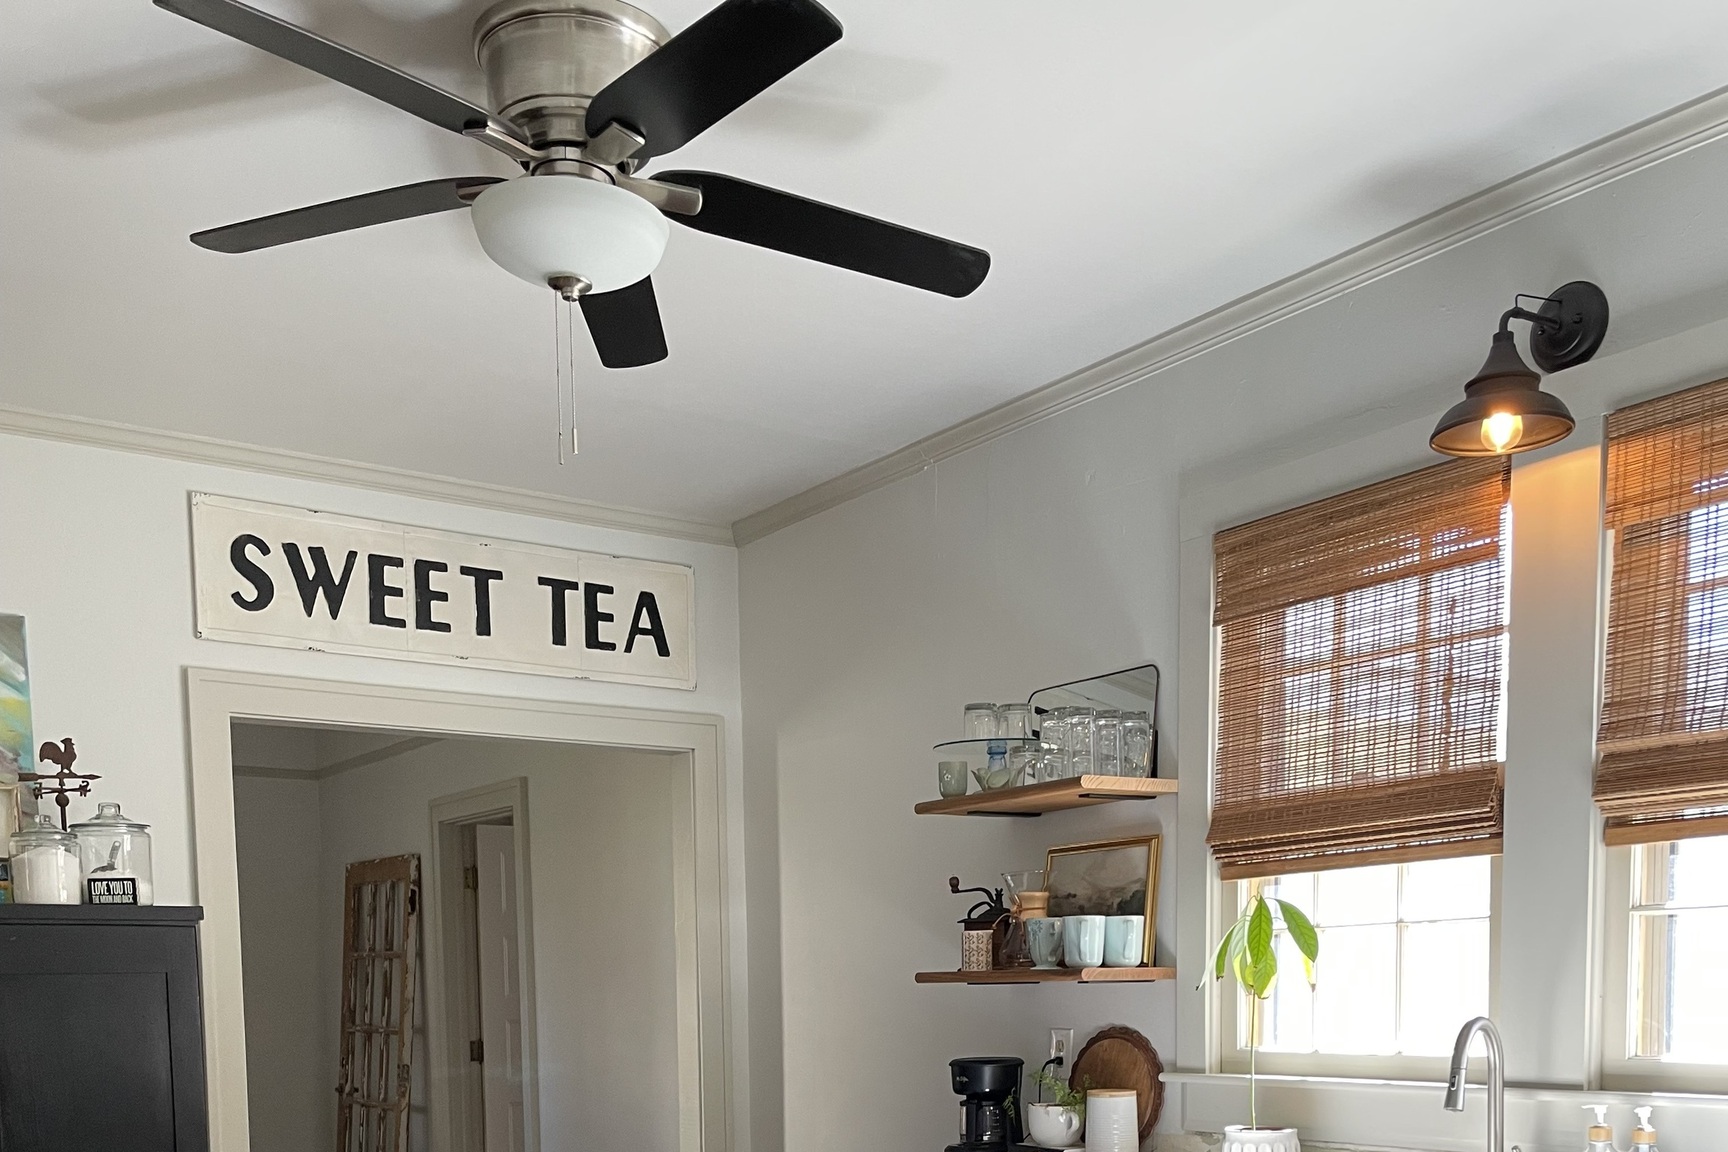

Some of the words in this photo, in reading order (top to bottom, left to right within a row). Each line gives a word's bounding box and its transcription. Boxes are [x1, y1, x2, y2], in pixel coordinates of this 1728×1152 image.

[230, 533, 504, 637] SWEET
[537, 576, 671, 658] TEA
[91, 880, 109, 895] LOVE
[109, 880, 123, 895] YOU
[123, 880, 133, 895] TO
